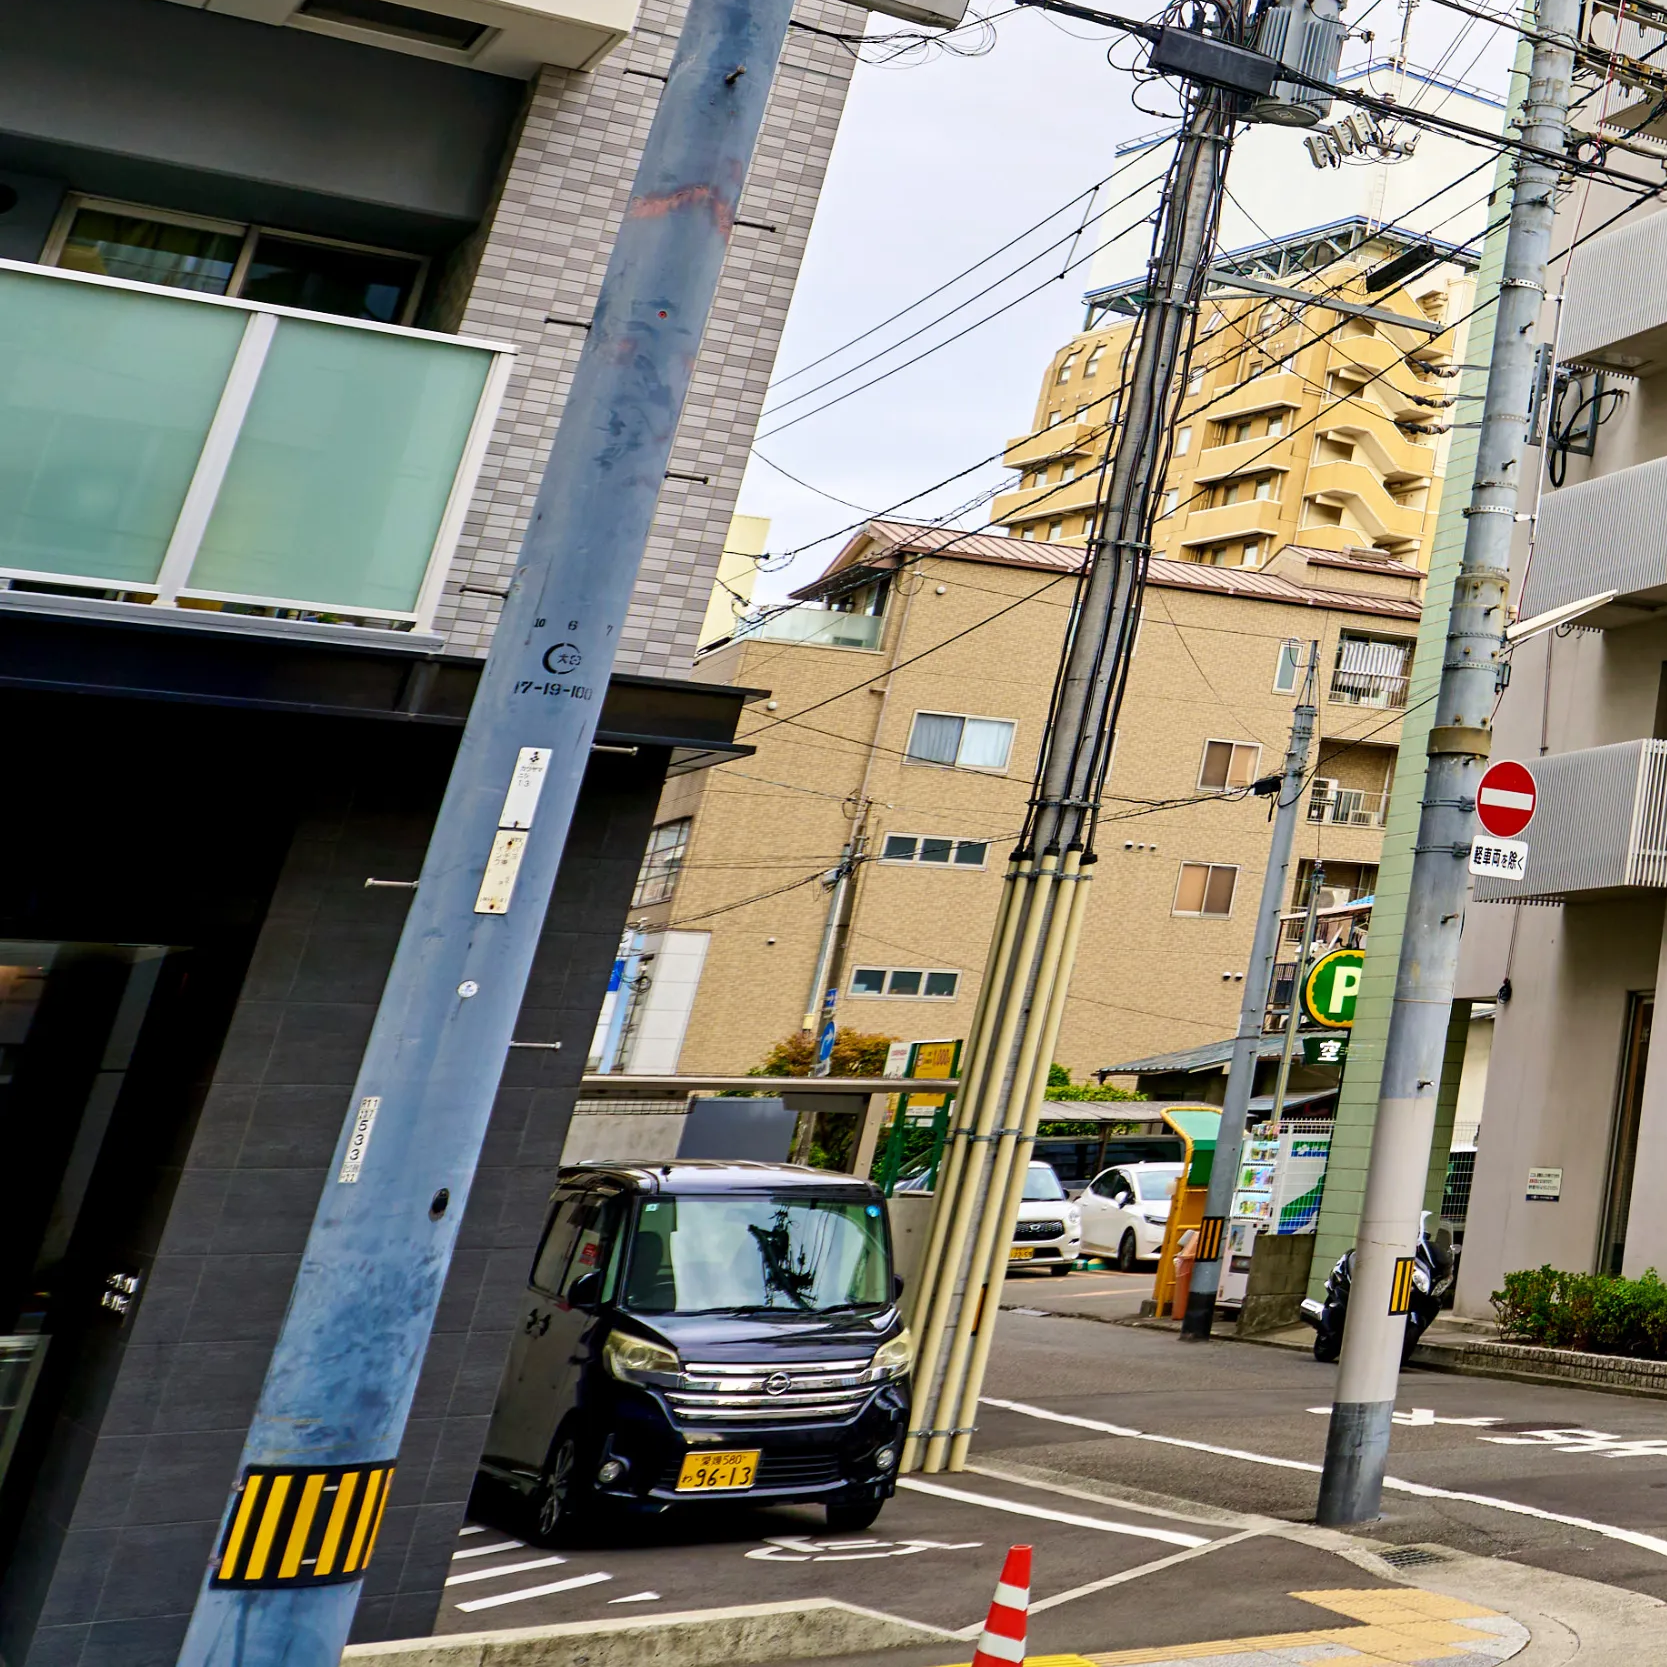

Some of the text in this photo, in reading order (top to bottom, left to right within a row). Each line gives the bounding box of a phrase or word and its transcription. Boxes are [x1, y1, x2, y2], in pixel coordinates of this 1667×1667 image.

[533, 617, 546, 628] 10
[568, 620, 578, 631] 6
[514, 680, 593, 701] 17-19-100
[1473, 845, 1525, 871] 軽車両を除く
[1329, 966, 1363, 1014] P
[1317, 1040, 1342, 1062] 空
[694, 1466, 752, 1488] 96-13
